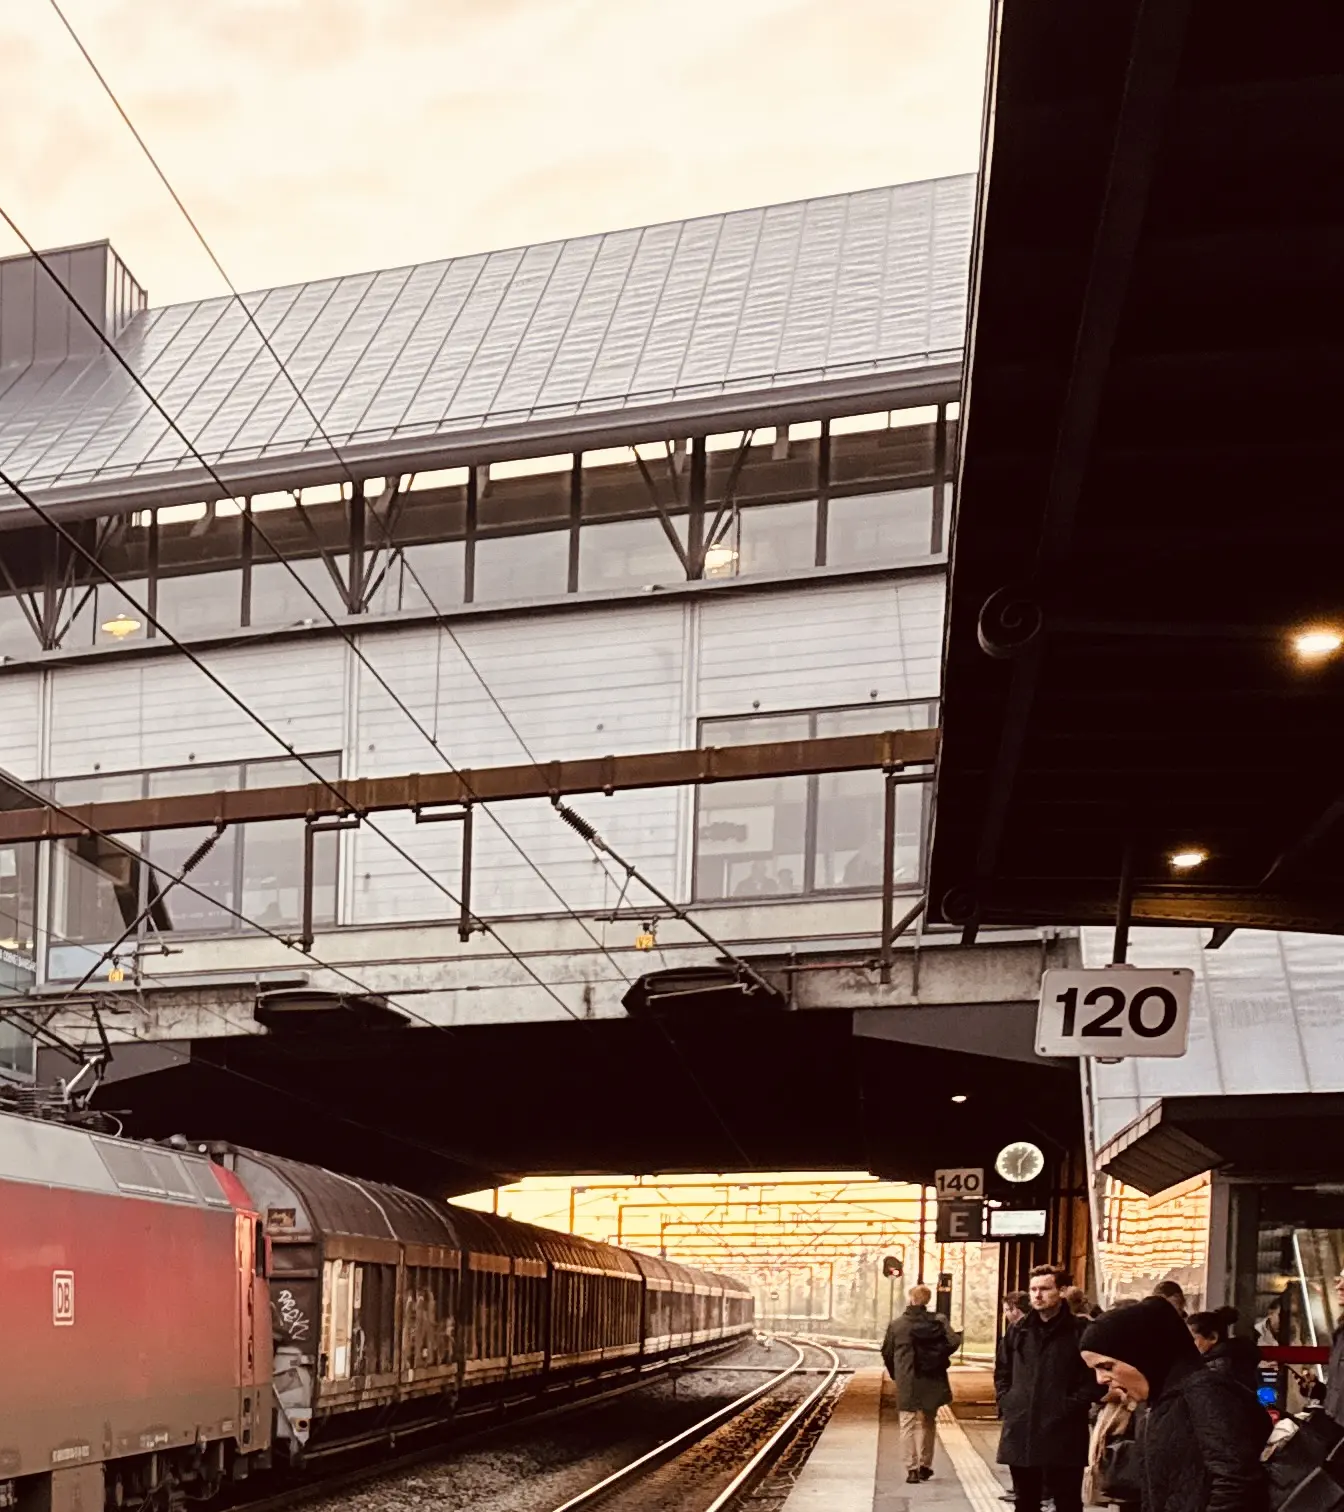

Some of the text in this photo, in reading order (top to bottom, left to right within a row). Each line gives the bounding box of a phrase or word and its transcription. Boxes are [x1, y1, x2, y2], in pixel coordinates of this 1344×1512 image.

[1056, 986, 1177, 1038] 120
[937, 1173, 980, 1192] 140
[950, 1212, 969, 1237] E
